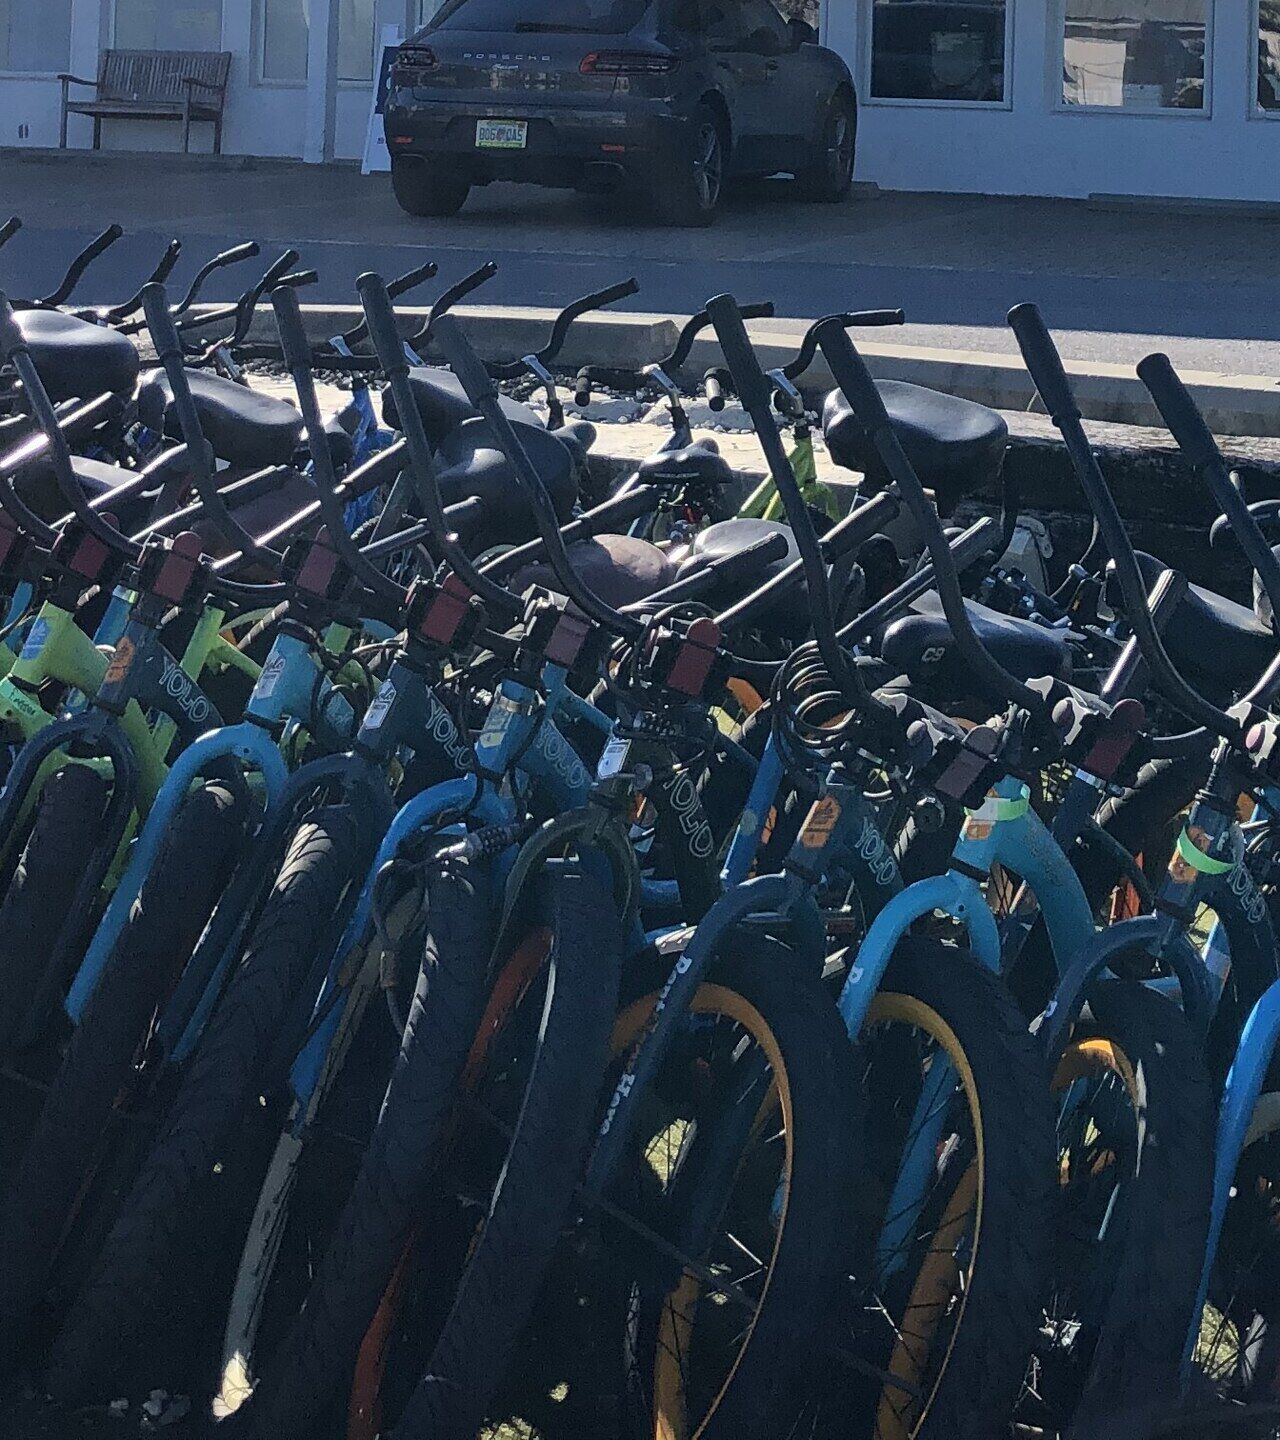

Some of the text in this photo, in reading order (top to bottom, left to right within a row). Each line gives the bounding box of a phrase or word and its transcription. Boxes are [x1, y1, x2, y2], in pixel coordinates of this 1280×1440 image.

[463, 52, 551, 61] PORSCHE
[157, 656, 210, 723] YOLO
[425, 684, 472, 771] YOLO
[854, 816, 899, 886] YOLO
